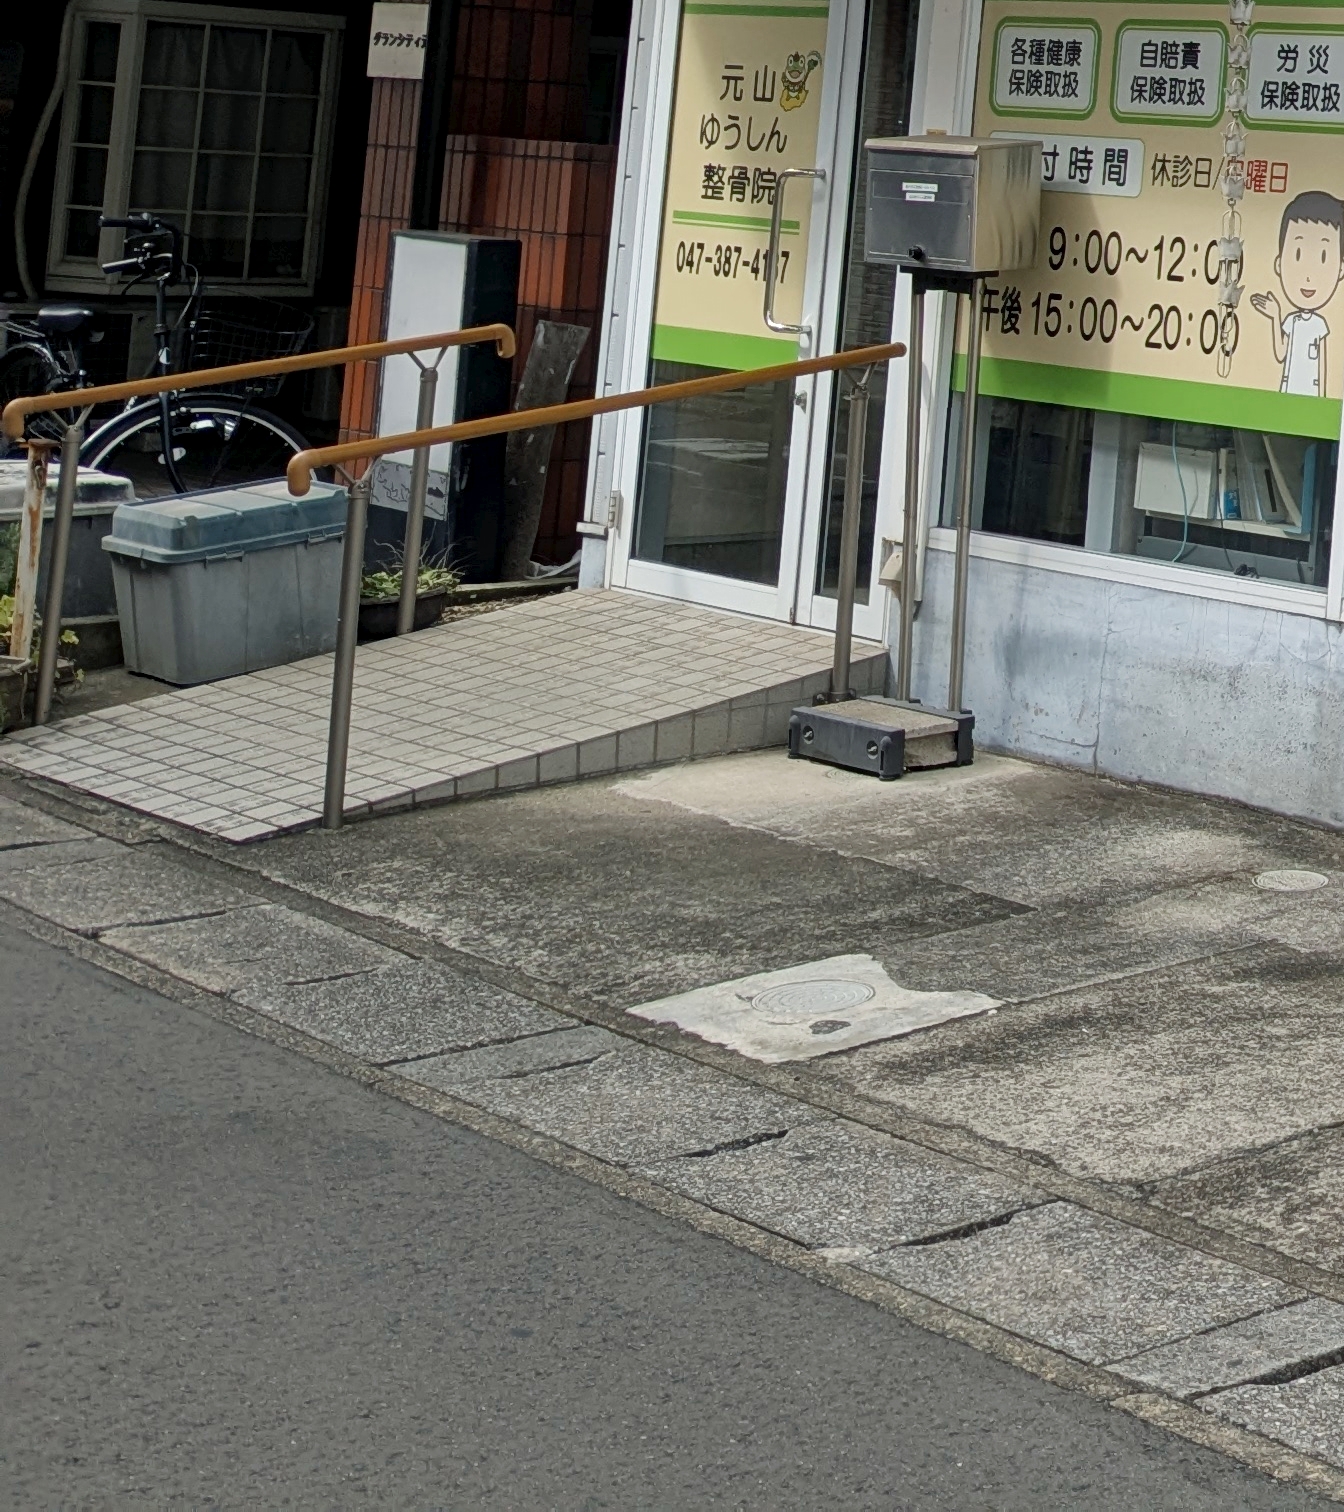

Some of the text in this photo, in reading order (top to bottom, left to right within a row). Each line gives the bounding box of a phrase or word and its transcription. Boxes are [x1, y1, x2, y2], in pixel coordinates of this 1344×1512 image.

[1010, 37, 1083, 67] 各種健康
[1139, 39, 1202, 71] 自賠責
[1276, 43, 1331, 75] 労災
[719, 64, 776, 103] 元山
[1008, 70, 1080, 100] 保険取扱
[1129, 75, 1207, 107] 保険取扱
[1260, 80, 1341, 114] 保険取扱
[700, 112, 788, 154] ゆうしん
[1040, 143, 1129, 187] 付時間
[701, 162, 777, 206] 整骨院
[676, 241, 790, 284] 047-387-417
